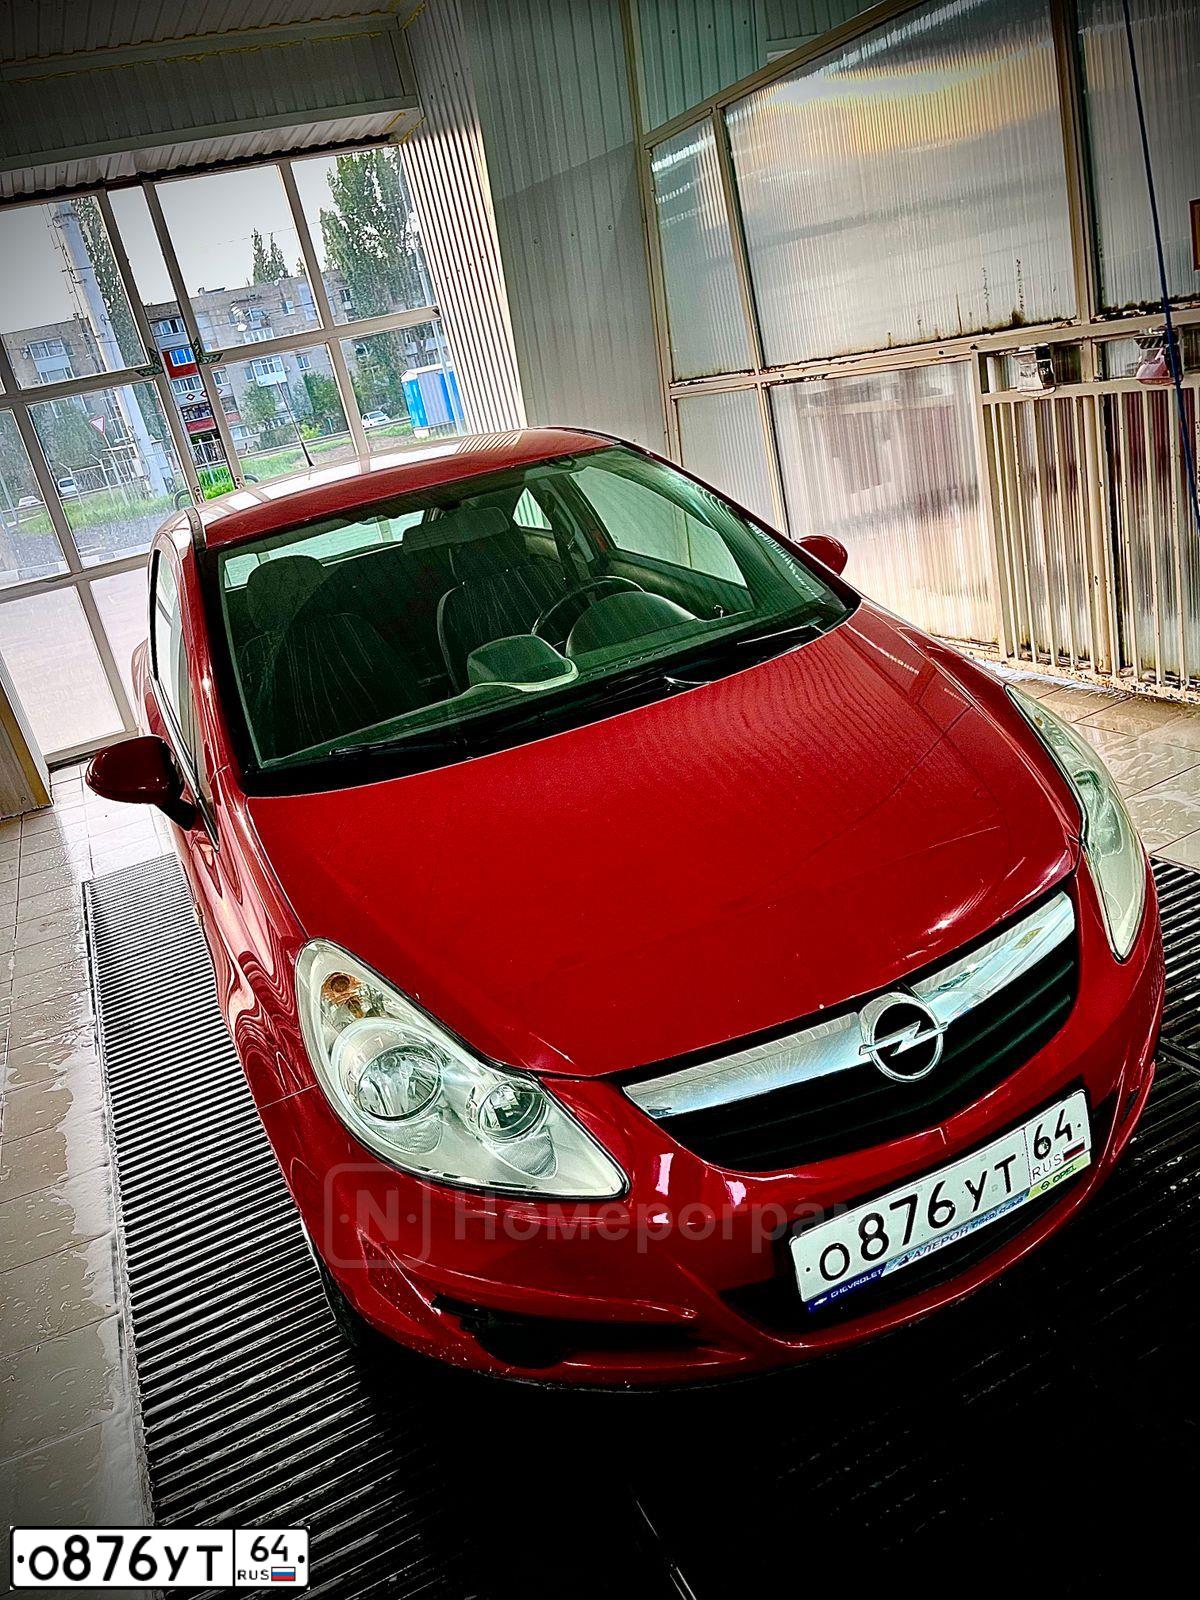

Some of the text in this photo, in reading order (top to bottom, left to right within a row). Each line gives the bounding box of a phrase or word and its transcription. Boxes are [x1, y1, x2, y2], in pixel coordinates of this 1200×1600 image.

[1031, 1153, 1063, 1181] RUS
[1052, 1164, 1077, 1184] OPEL
[819, 1154, 1017, 1282] О876УТ
[1033, 1108, 1074, 1160] 64
[830, 1268, 884, 1299] CHEVROLET
